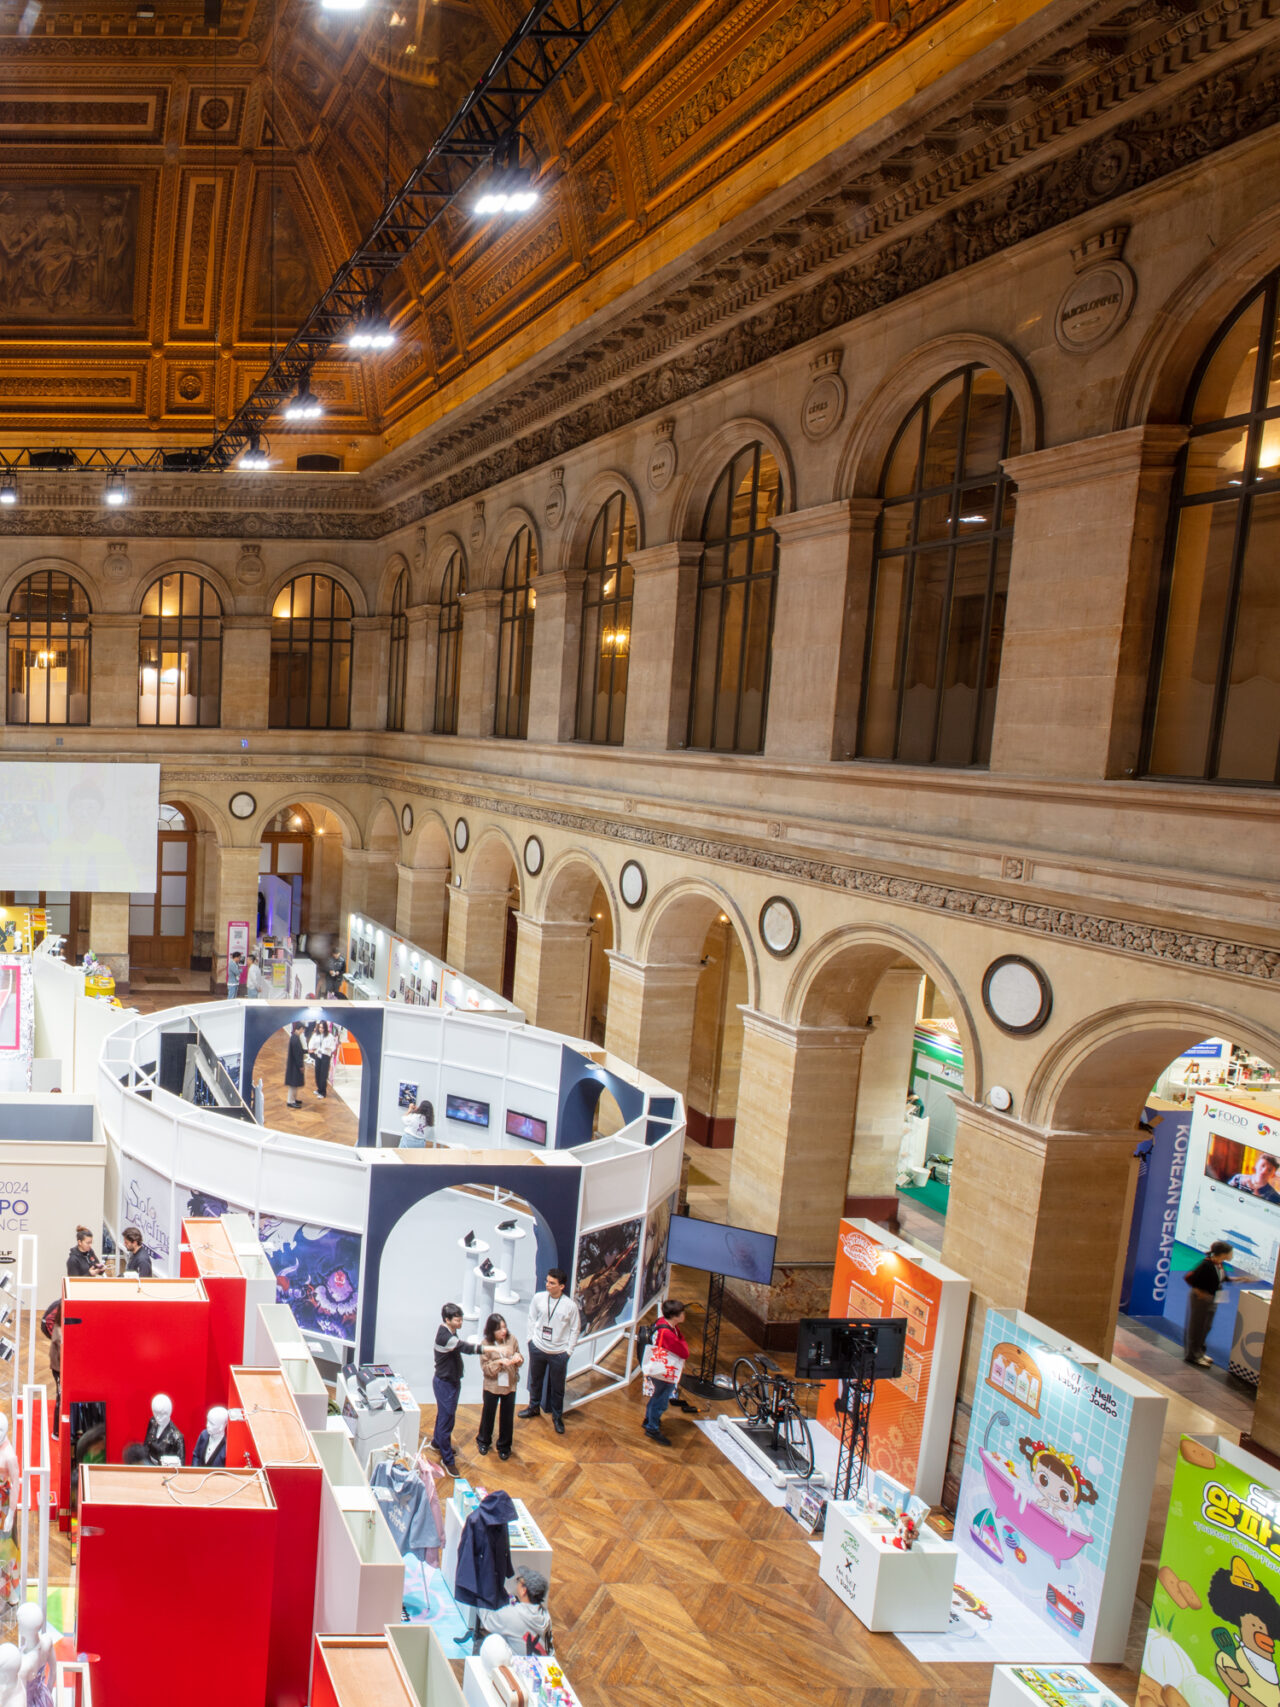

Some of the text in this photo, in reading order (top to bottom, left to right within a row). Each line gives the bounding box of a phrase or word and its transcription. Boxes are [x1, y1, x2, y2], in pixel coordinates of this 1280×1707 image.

[1152, 1124, 1190, 1301] KOREAN SEAFOOD
[1089, 1394, 1118, 1417] Jadoo
[1094, 1386, 1117, 1407] Hello
